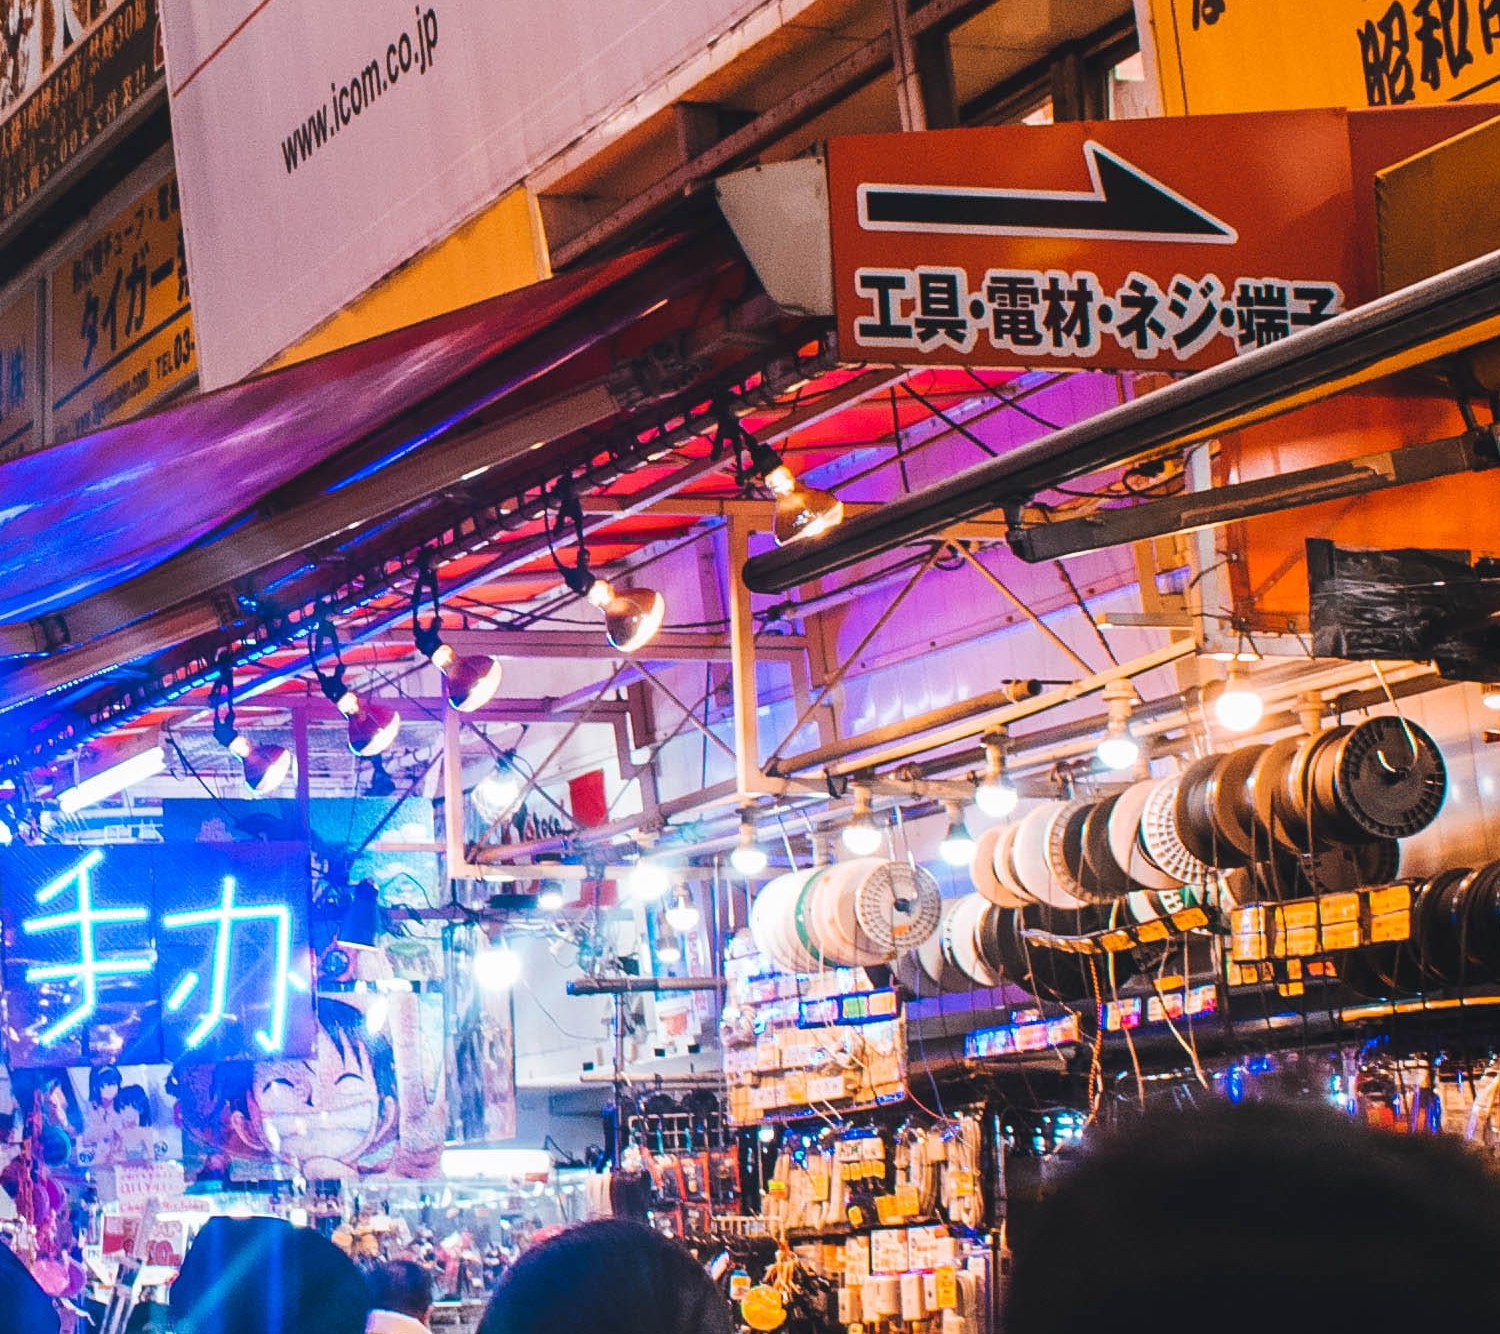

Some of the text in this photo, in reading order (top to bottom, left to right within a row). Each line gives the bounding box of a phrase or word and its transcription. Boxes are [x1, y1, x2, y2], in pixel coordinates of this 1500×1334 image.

[281, 4, 439, 175] www.icom.co.jp
[856, 266, 1346, 361] 工具・電材・ネジ・端子
